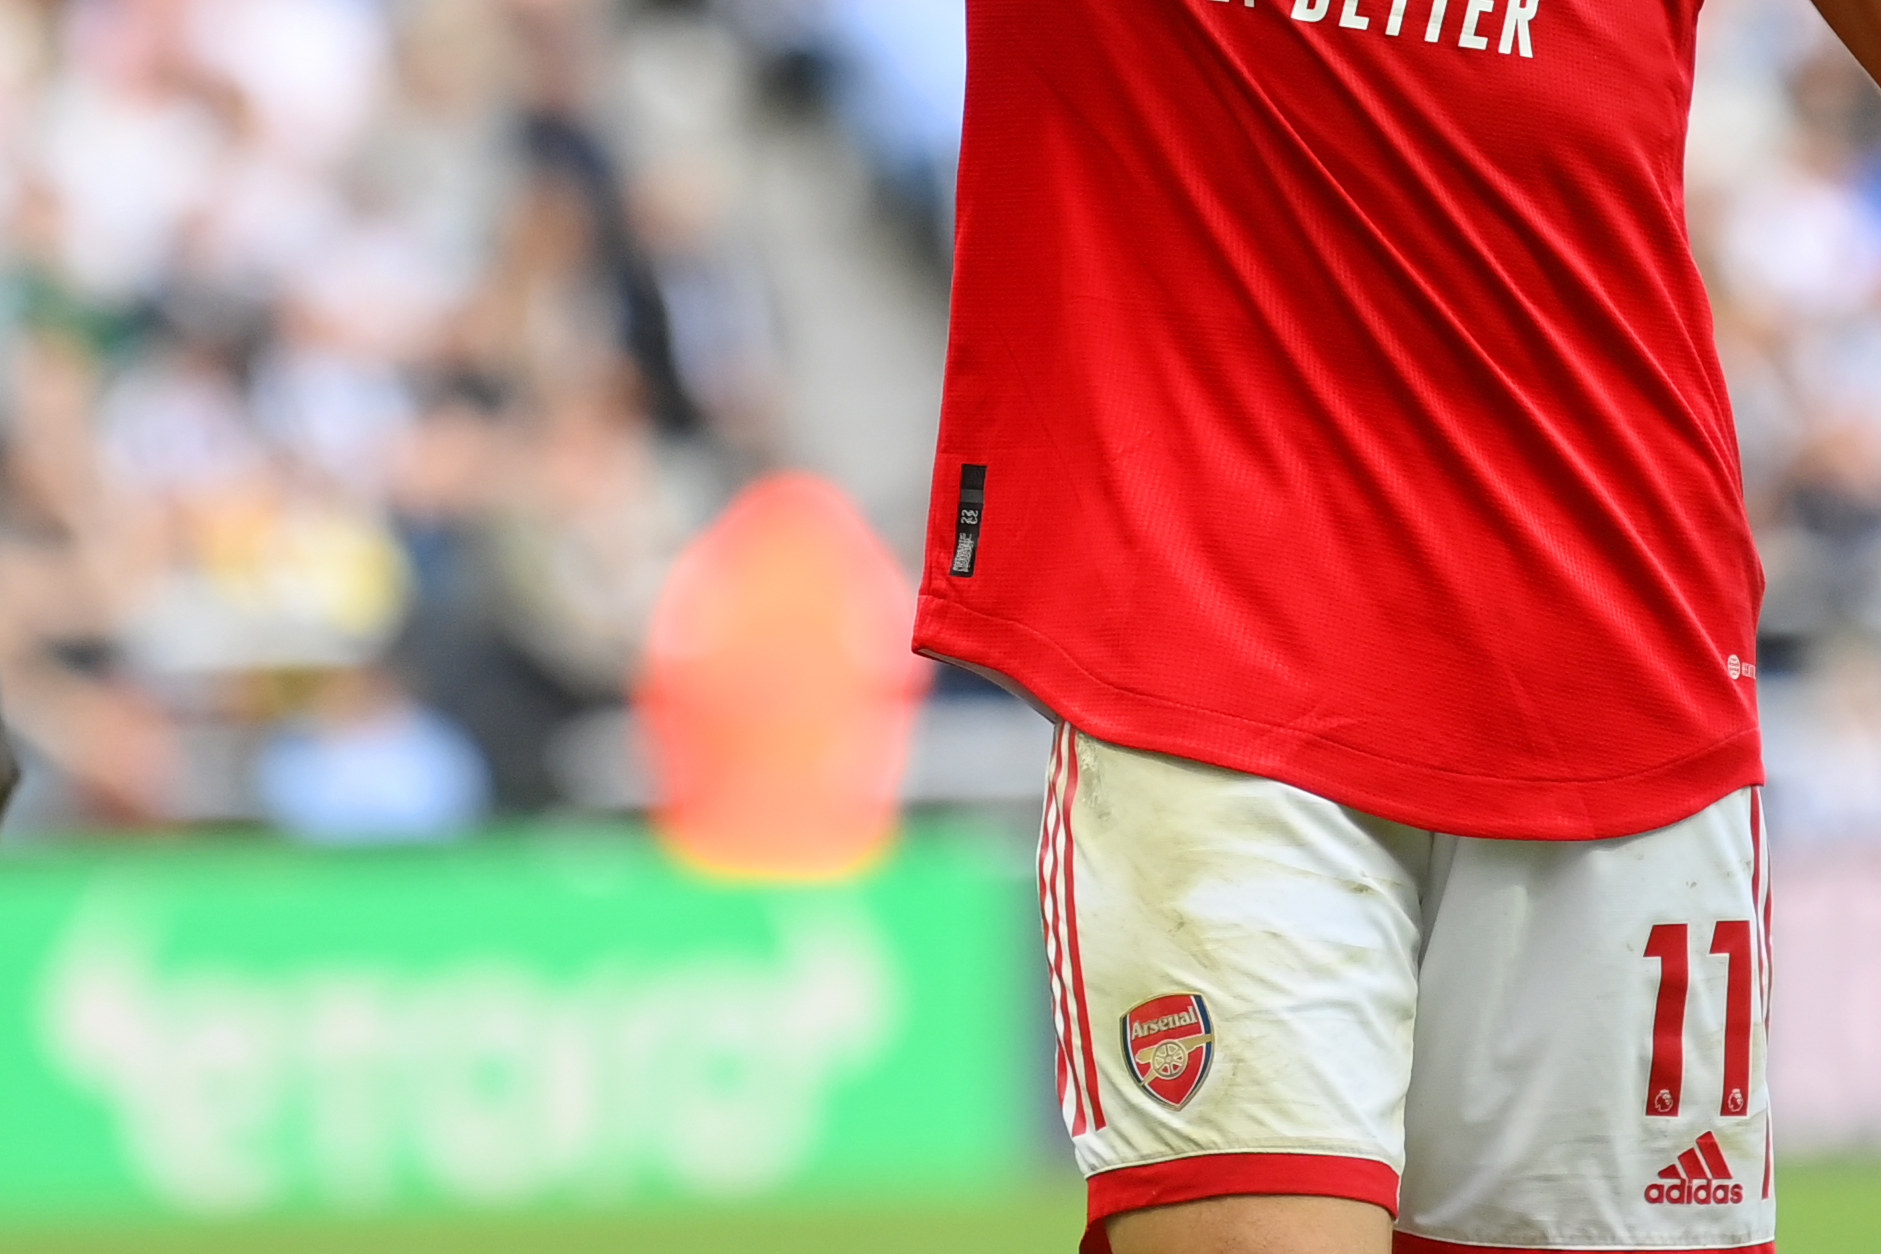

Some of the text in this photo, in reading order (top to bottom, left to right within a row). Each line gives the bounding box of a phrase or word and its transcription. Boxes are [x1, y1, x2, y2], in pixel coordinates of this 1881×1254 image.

[1131, 1005, 1198, 1041] Arsenal
[1642, 919, 1752, 1118] 11
[1644, 1178, 1743, 1205] adidas
